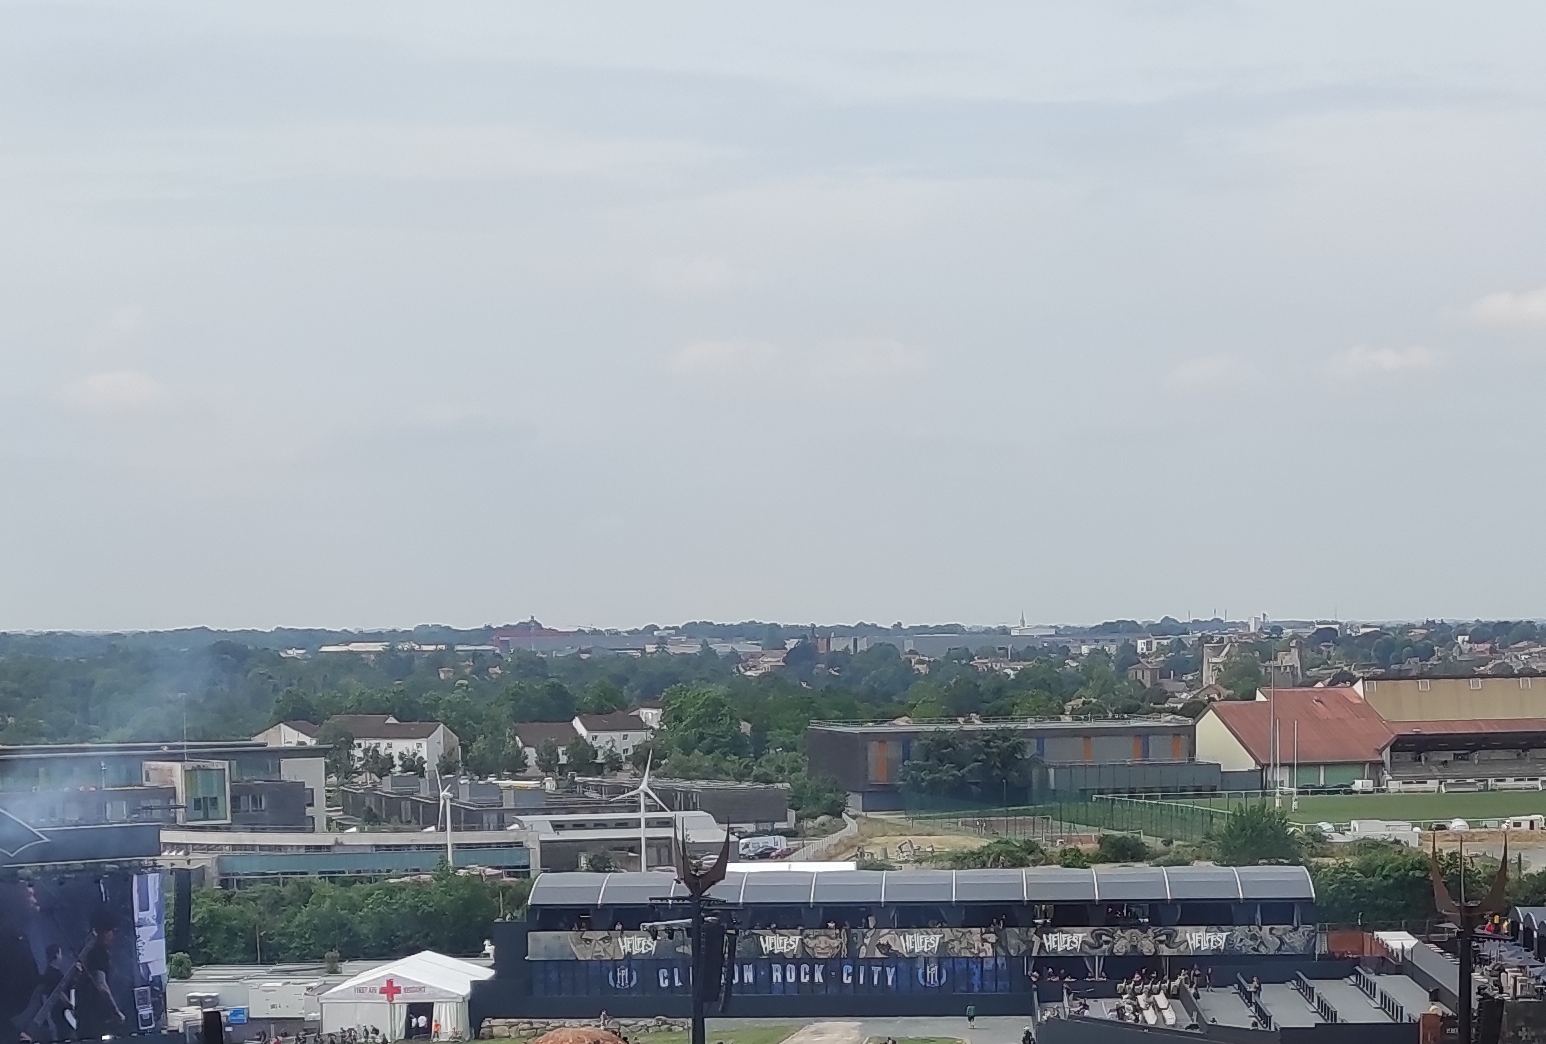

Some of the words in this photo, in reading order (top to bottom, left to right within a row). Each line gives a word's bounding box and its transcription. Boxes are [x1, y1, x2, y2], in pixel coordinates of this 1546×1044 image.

[760, 933, 803, 955] HELLFEST
[900, 932, 943, 954] HELLFEST
[1042, 931, 1087, 953] HELLFEST
[1186, 930, 1233, 955] HELLFEST
[658, 963, 754, 988] CLION
[772, 963, 825, 983] ROCK
[842, 964, 896, 986] CITY
